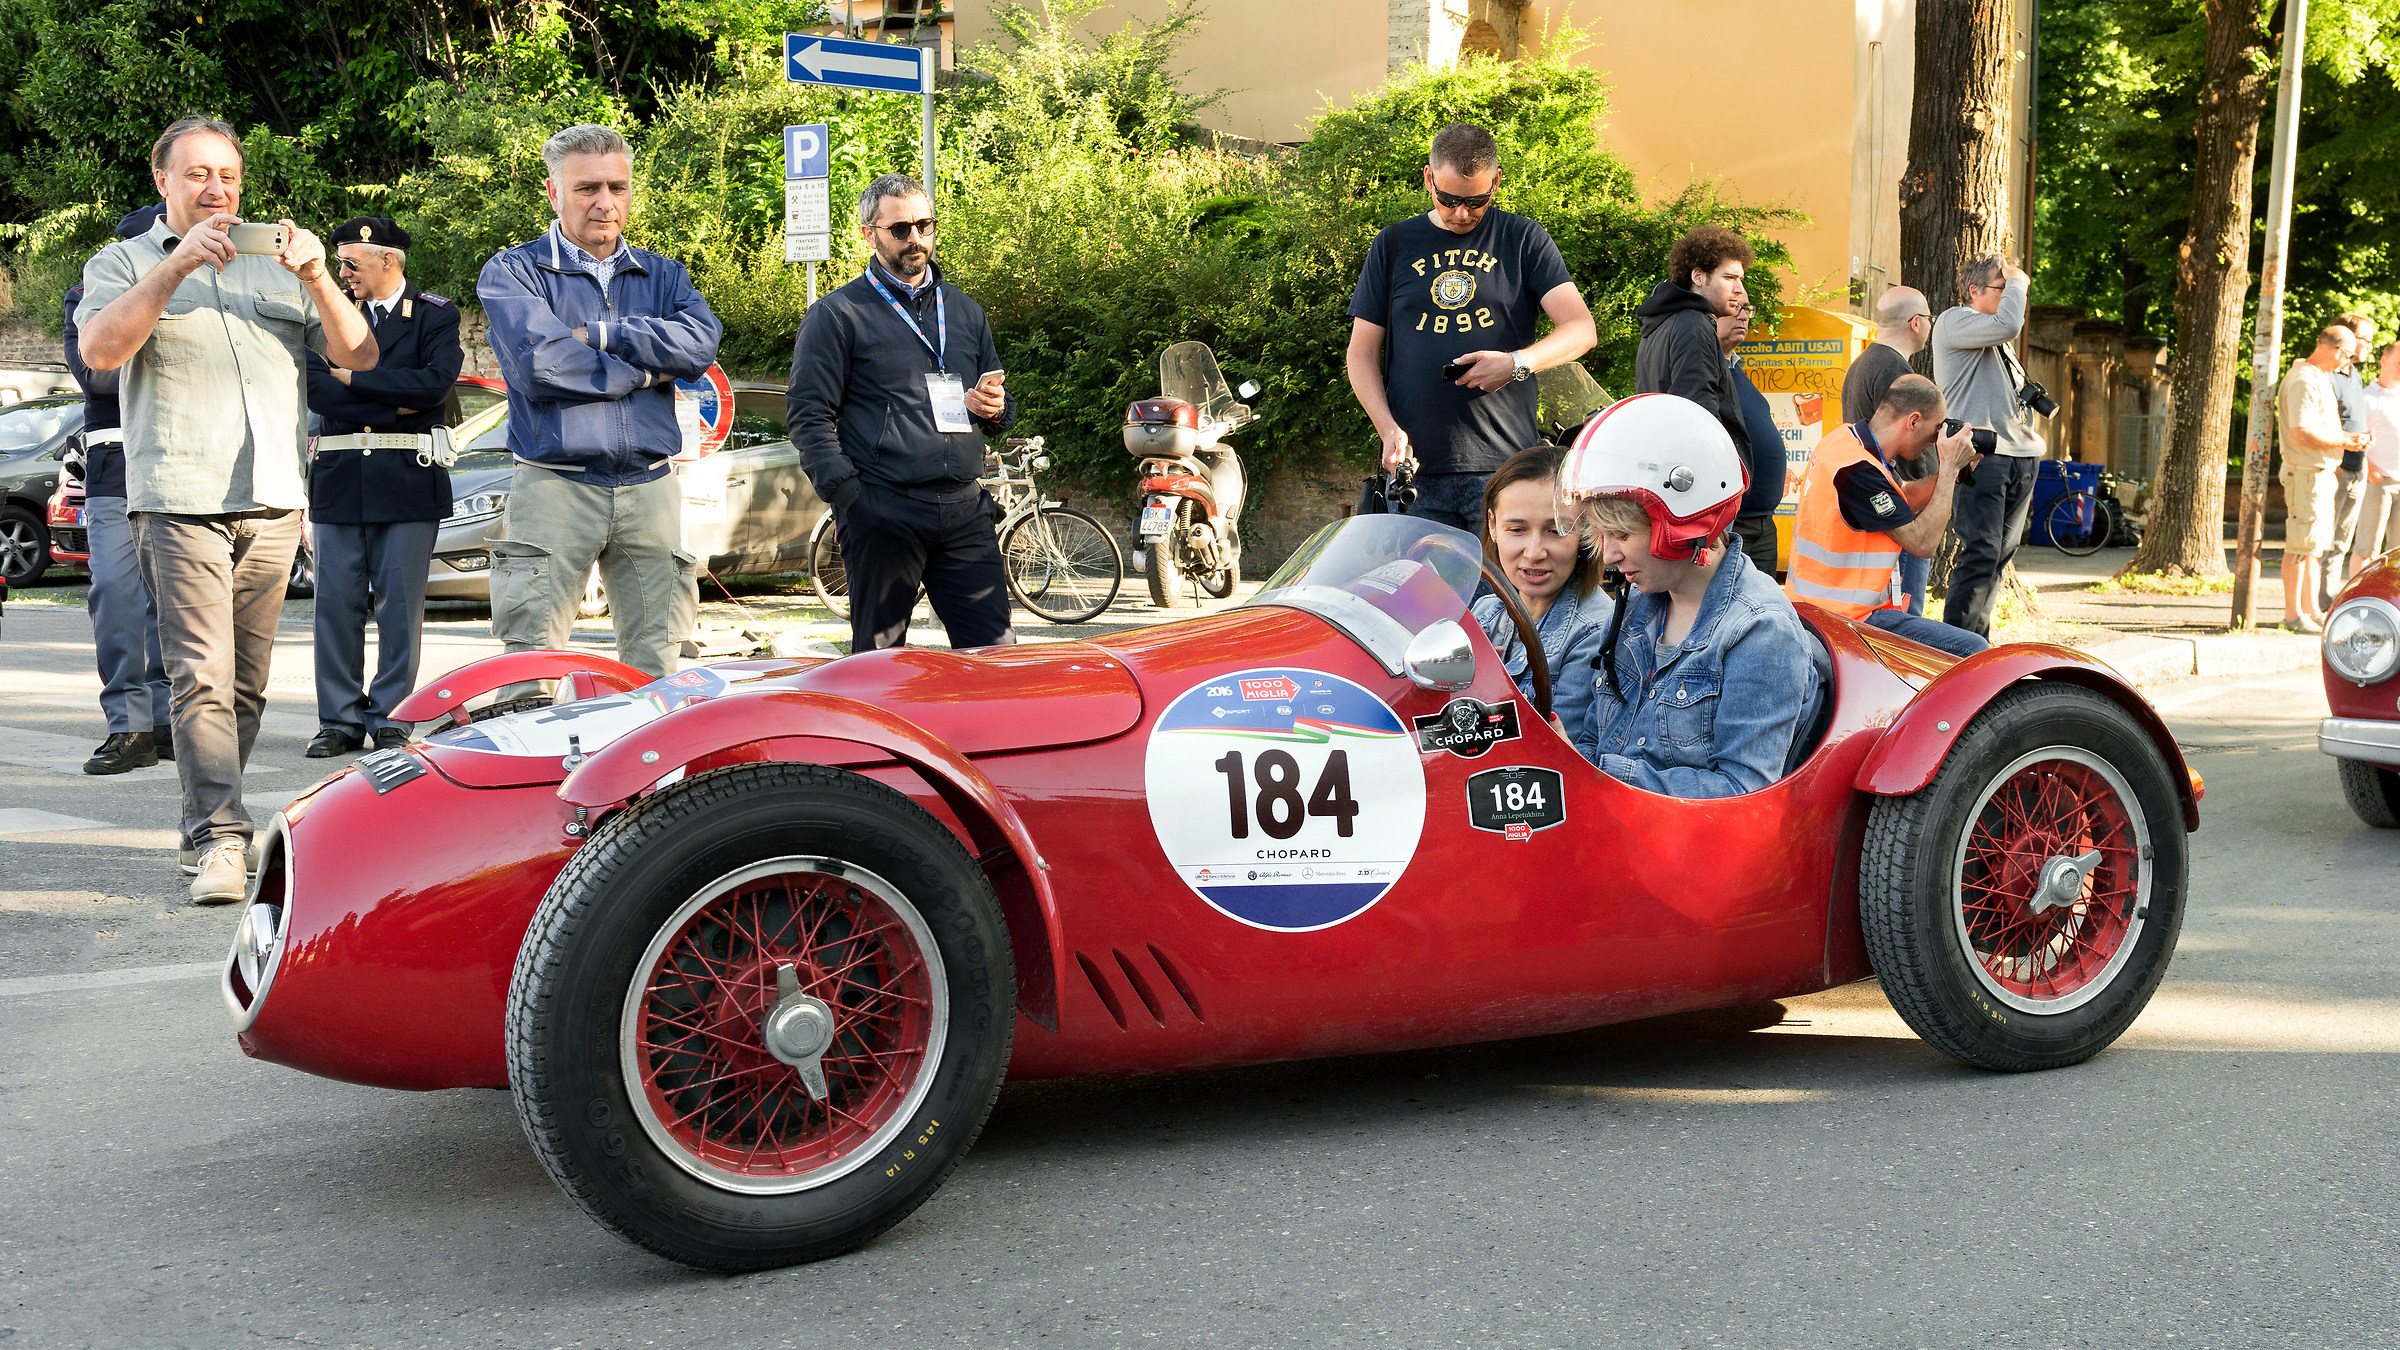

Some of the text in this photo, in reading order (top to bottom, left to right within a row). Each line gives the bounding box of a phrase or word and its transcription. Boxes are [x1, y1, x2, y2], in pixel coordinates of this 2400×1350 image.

[793, 130, 820, 174] P
[1412, 249, 1498, 277] FITCH
[1415, 307, 1495, 334] 1892
[1734, 342, 1841, 353] accolta ABITI USATI
[1746, 357, 1833, 368] Caritas di Parma
[1780, 429, 1802, 440] ECHI
[1786, 447, 1811, 461] RIETÀ
[1149, 508, 1160, 519] BK
[1142, 521, 1169, 532] 44783
[1205, 680, 1283, 697] 2016 1000
[1246, 689, 1289, 699] MIGLIA
[1279, 706, 1291, 714] FIA
[1435, 728, 1504, 747] CHOPARD
[1215, 749, 1359, 840] 184
[1490, 781, 1546, 812] 184
[1508, 811, 1545, 820] Lepetukhina
[1256, 849, 1332, 860] CHOPARD
[885, 1119, 940, 1178] 145 R 14
